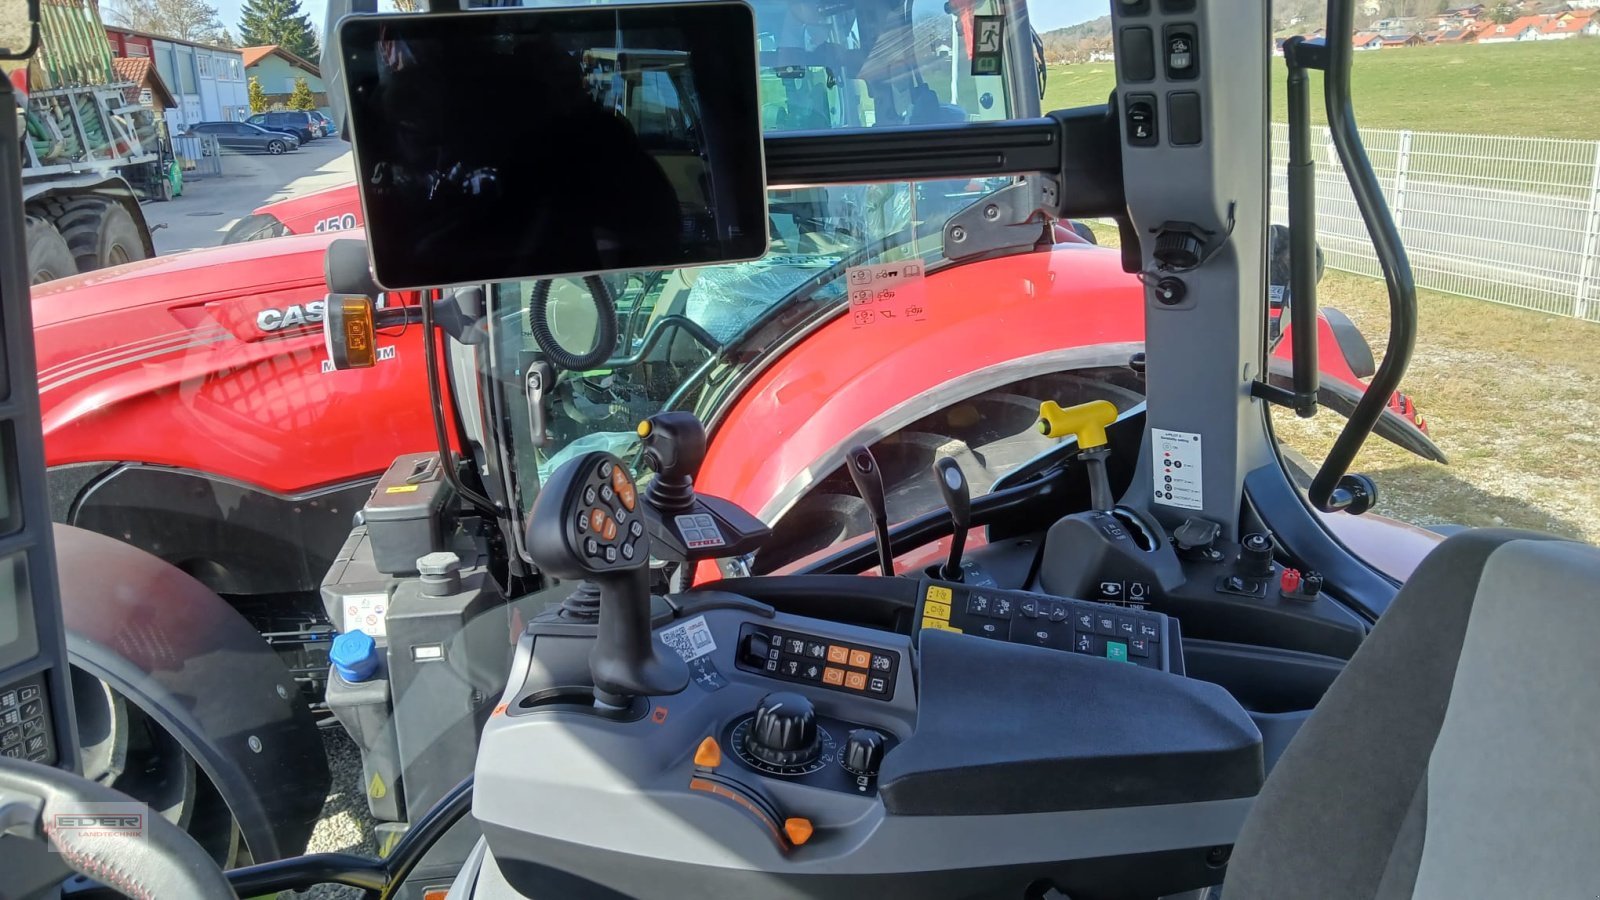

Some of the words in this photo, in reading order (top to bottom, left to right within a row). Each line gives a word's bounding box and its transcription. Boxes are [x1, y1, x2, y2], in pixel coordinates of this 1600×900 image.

[315, 214, 356, 232] 150
[256, 301, 326, 331] CAS
[688, 538, 724, 547] STOLL
